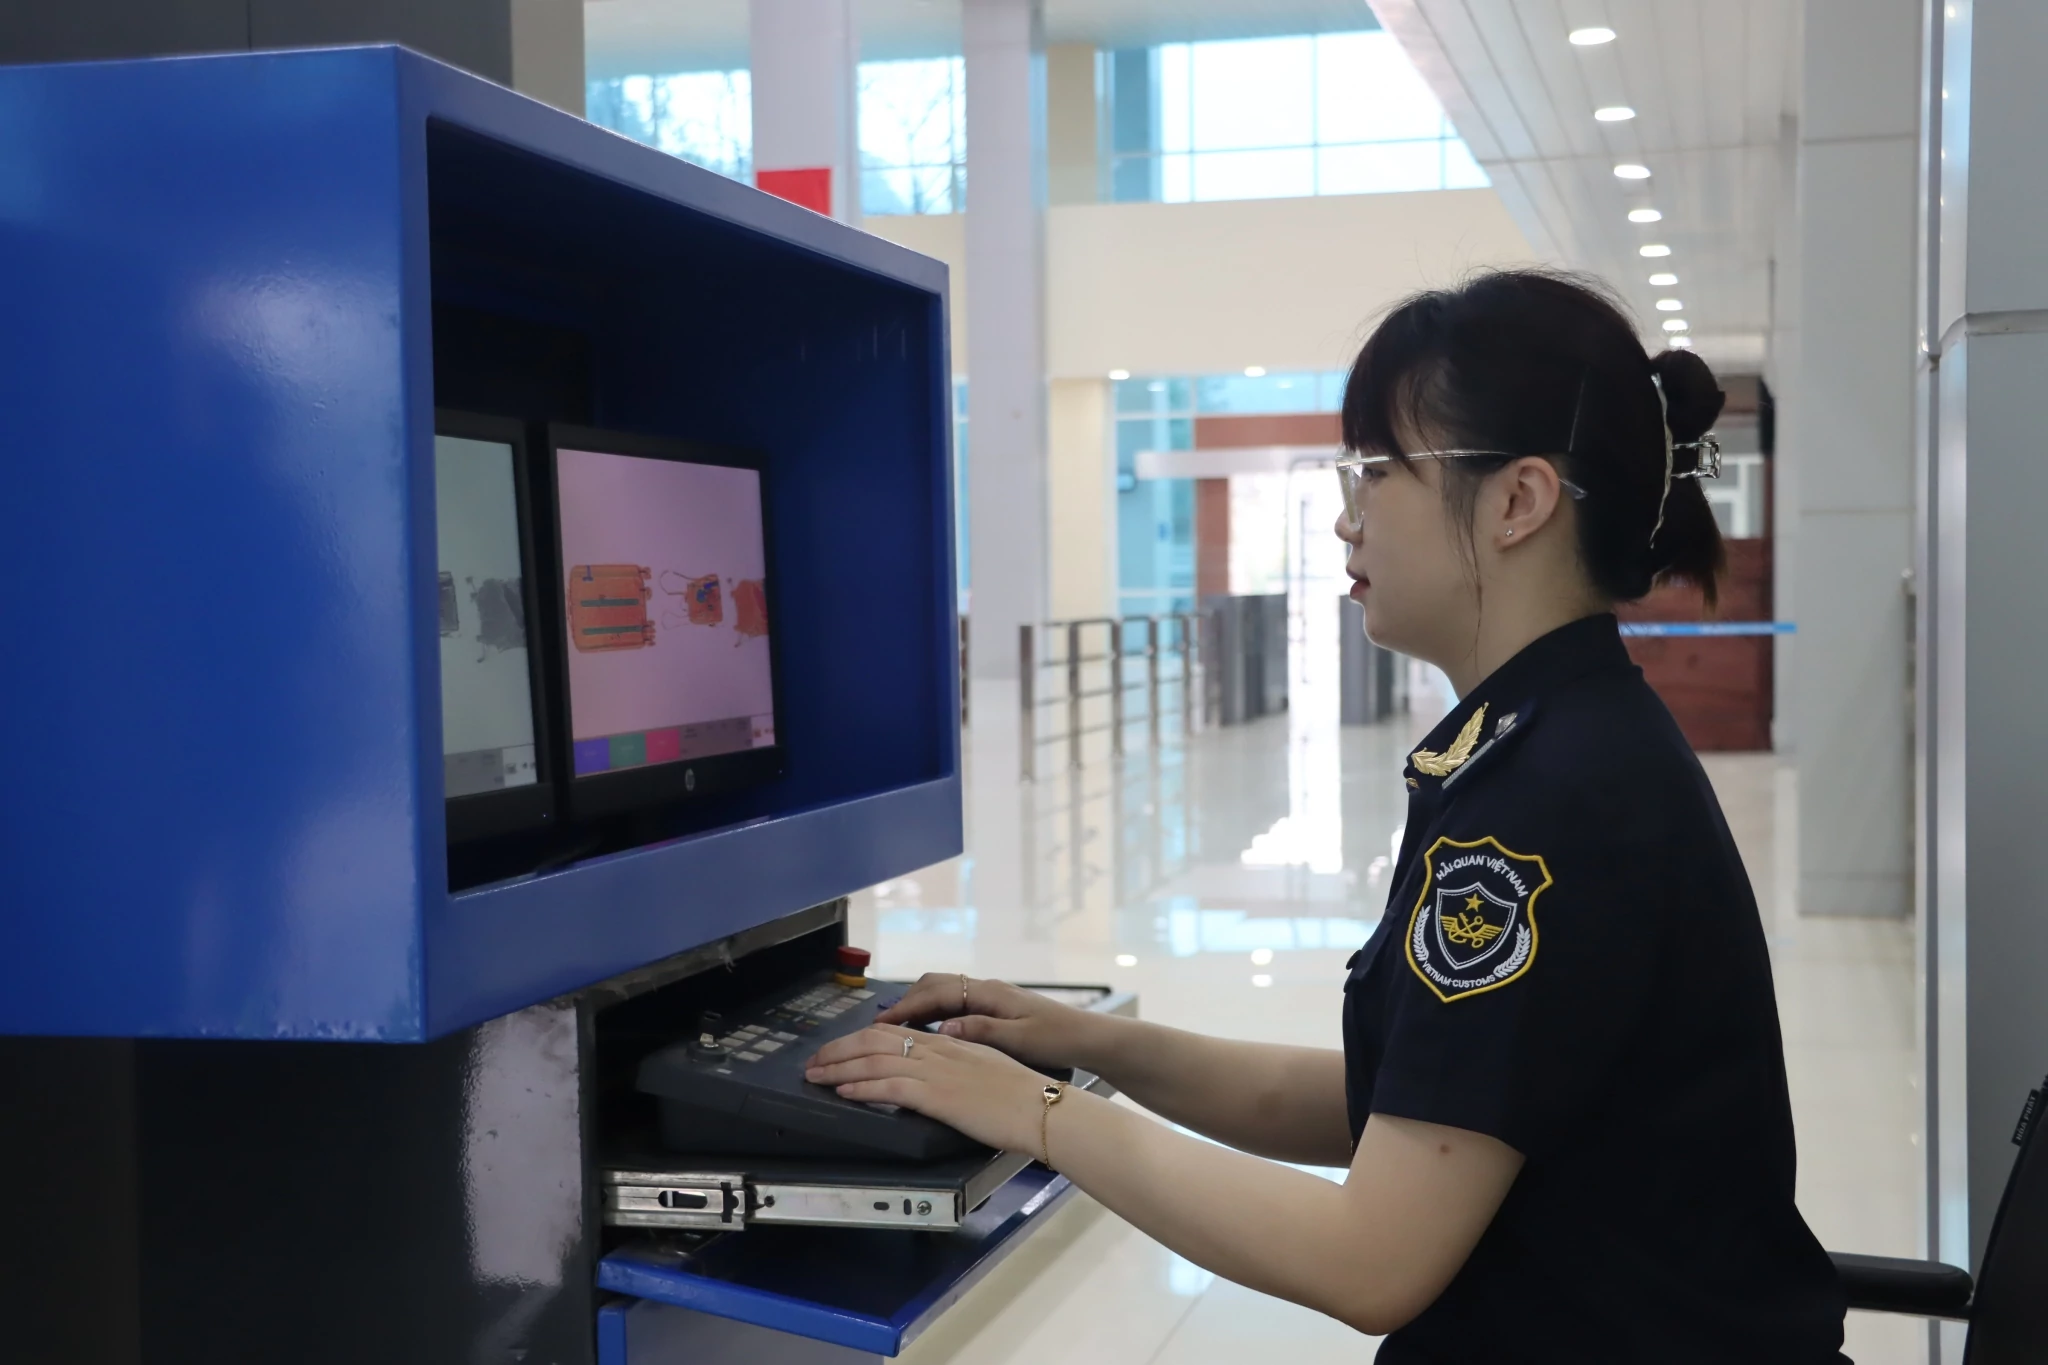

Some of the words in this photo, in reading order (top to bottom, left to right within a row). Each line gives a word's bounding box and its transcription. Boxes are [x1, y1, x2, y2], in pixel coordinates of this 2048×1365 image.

[1436, 862, 1454, 880] HẢI
[1454, 855, 1485, 869] QUAN
[1486, 856, 1510, 874] VIỆT
[1506, 870, 1528, 897] NAM
[1422, 961, 1451, 986] VIETNAM
[1452, 975, 1495, 988] CUSTOMS
